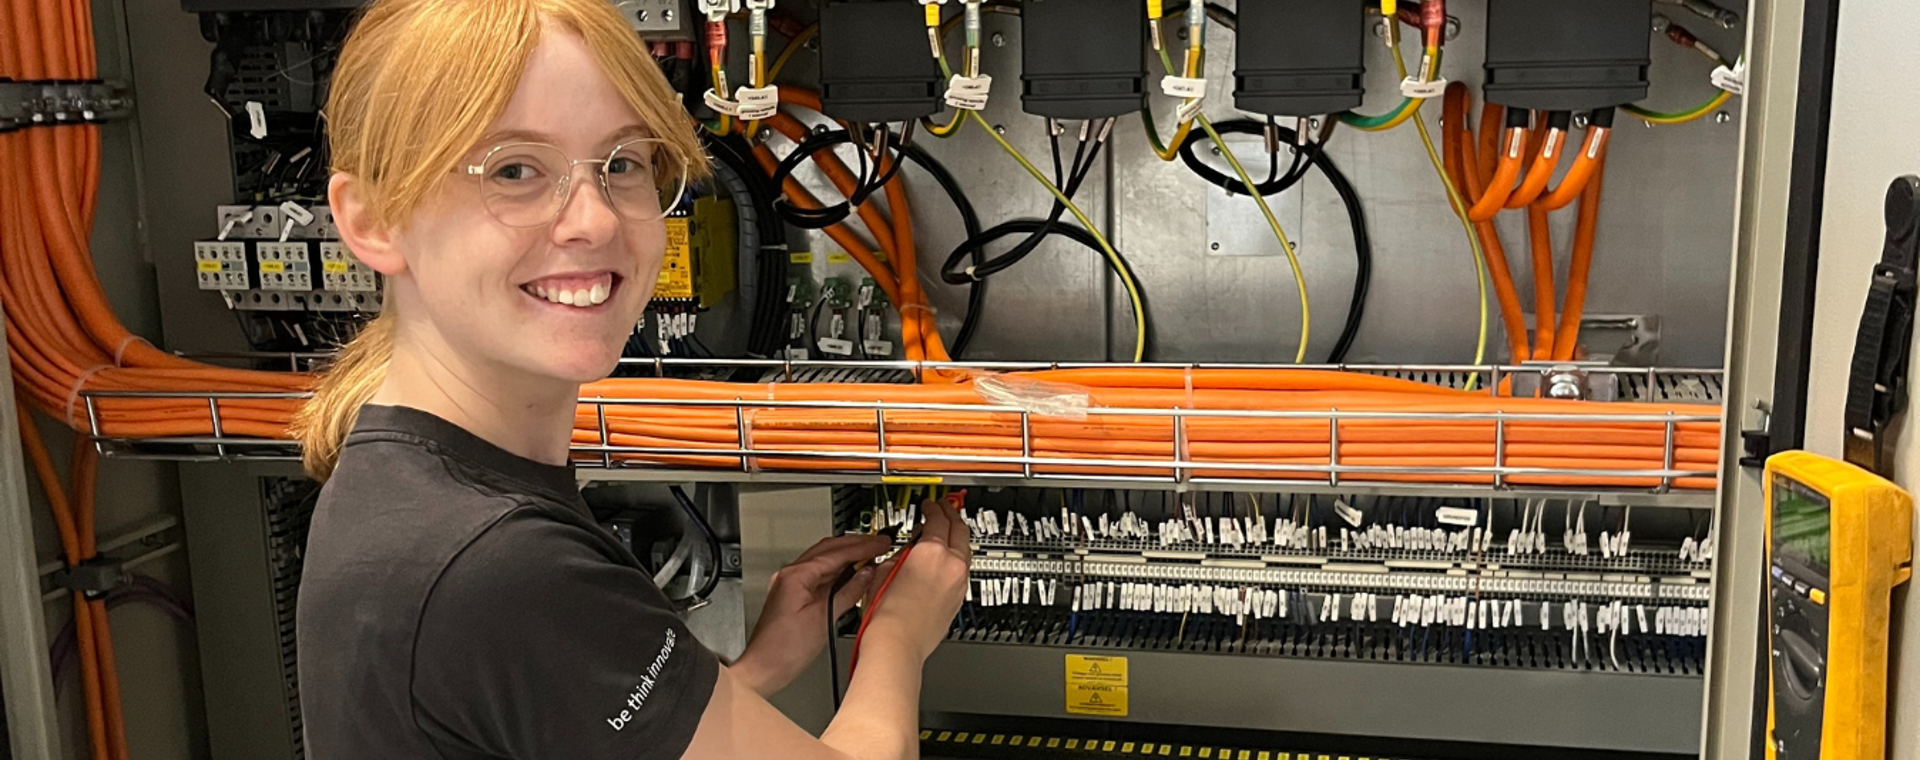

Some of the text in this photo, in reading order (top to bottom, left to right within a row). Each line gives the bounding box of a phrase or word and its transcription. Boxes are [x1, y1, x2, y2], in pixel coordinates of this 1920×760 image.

[607, 628, 676, 730] be think innovate
